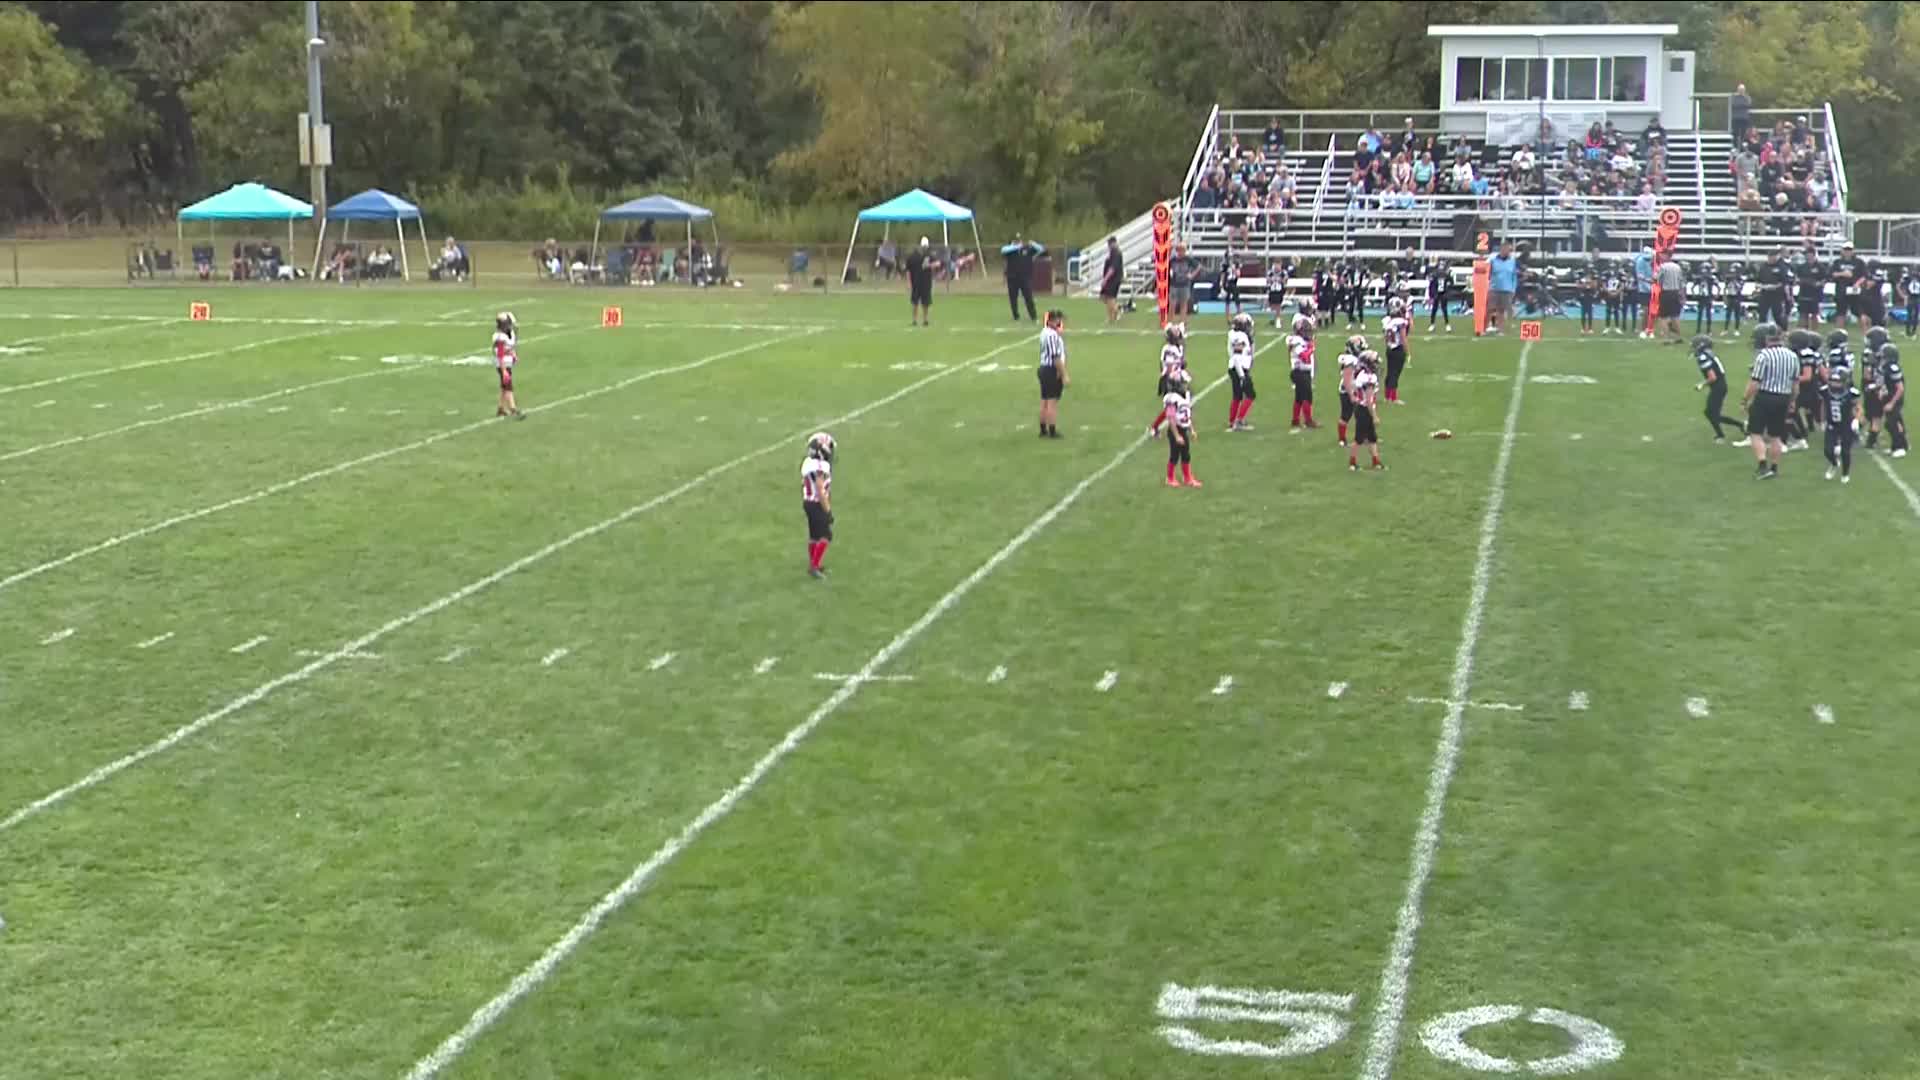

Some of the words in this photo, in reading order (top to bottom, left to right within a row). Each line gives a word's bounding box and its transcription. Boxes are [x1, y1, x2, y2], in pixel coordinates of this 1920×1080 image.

[1477, 232, 1490, 251] 2
[1522, 324, 1539, 337] 50
[1157, 983, 1626, 1077] 50
